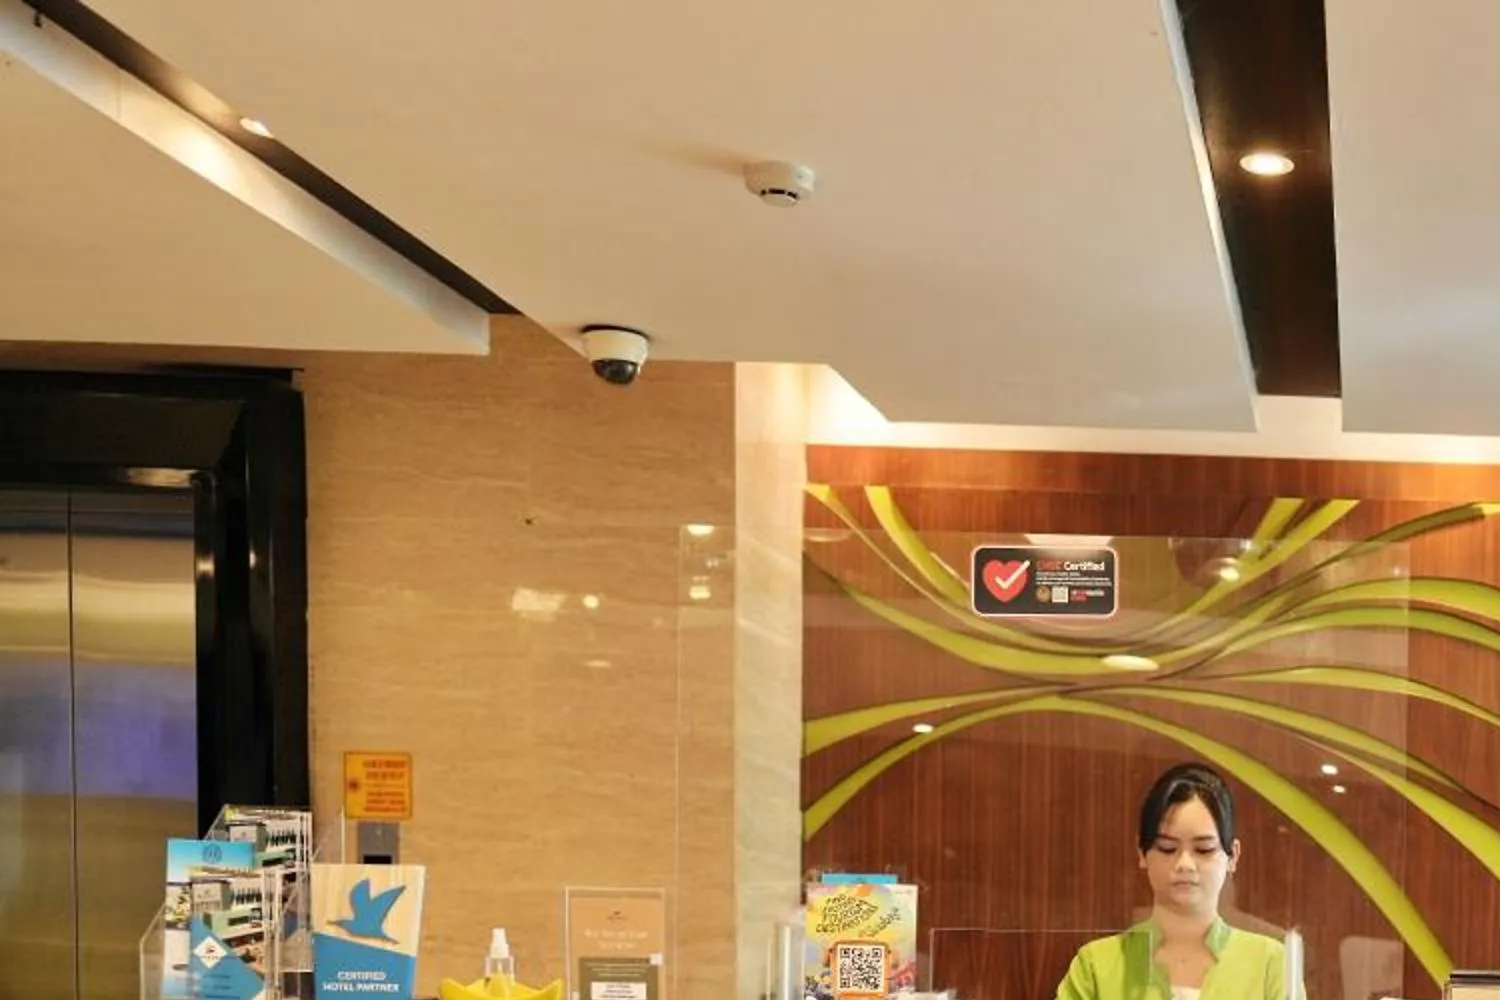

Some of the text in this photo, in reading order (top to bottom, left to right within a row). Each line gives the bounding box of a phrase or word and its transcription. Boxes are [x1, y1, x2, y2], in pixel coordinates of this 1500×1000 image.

[1064, 561, 1105, 571] Certified
[337, 971, 386, 981] CERTIFIED
[323, 982, 400, 993] HOTEL PARTNER
